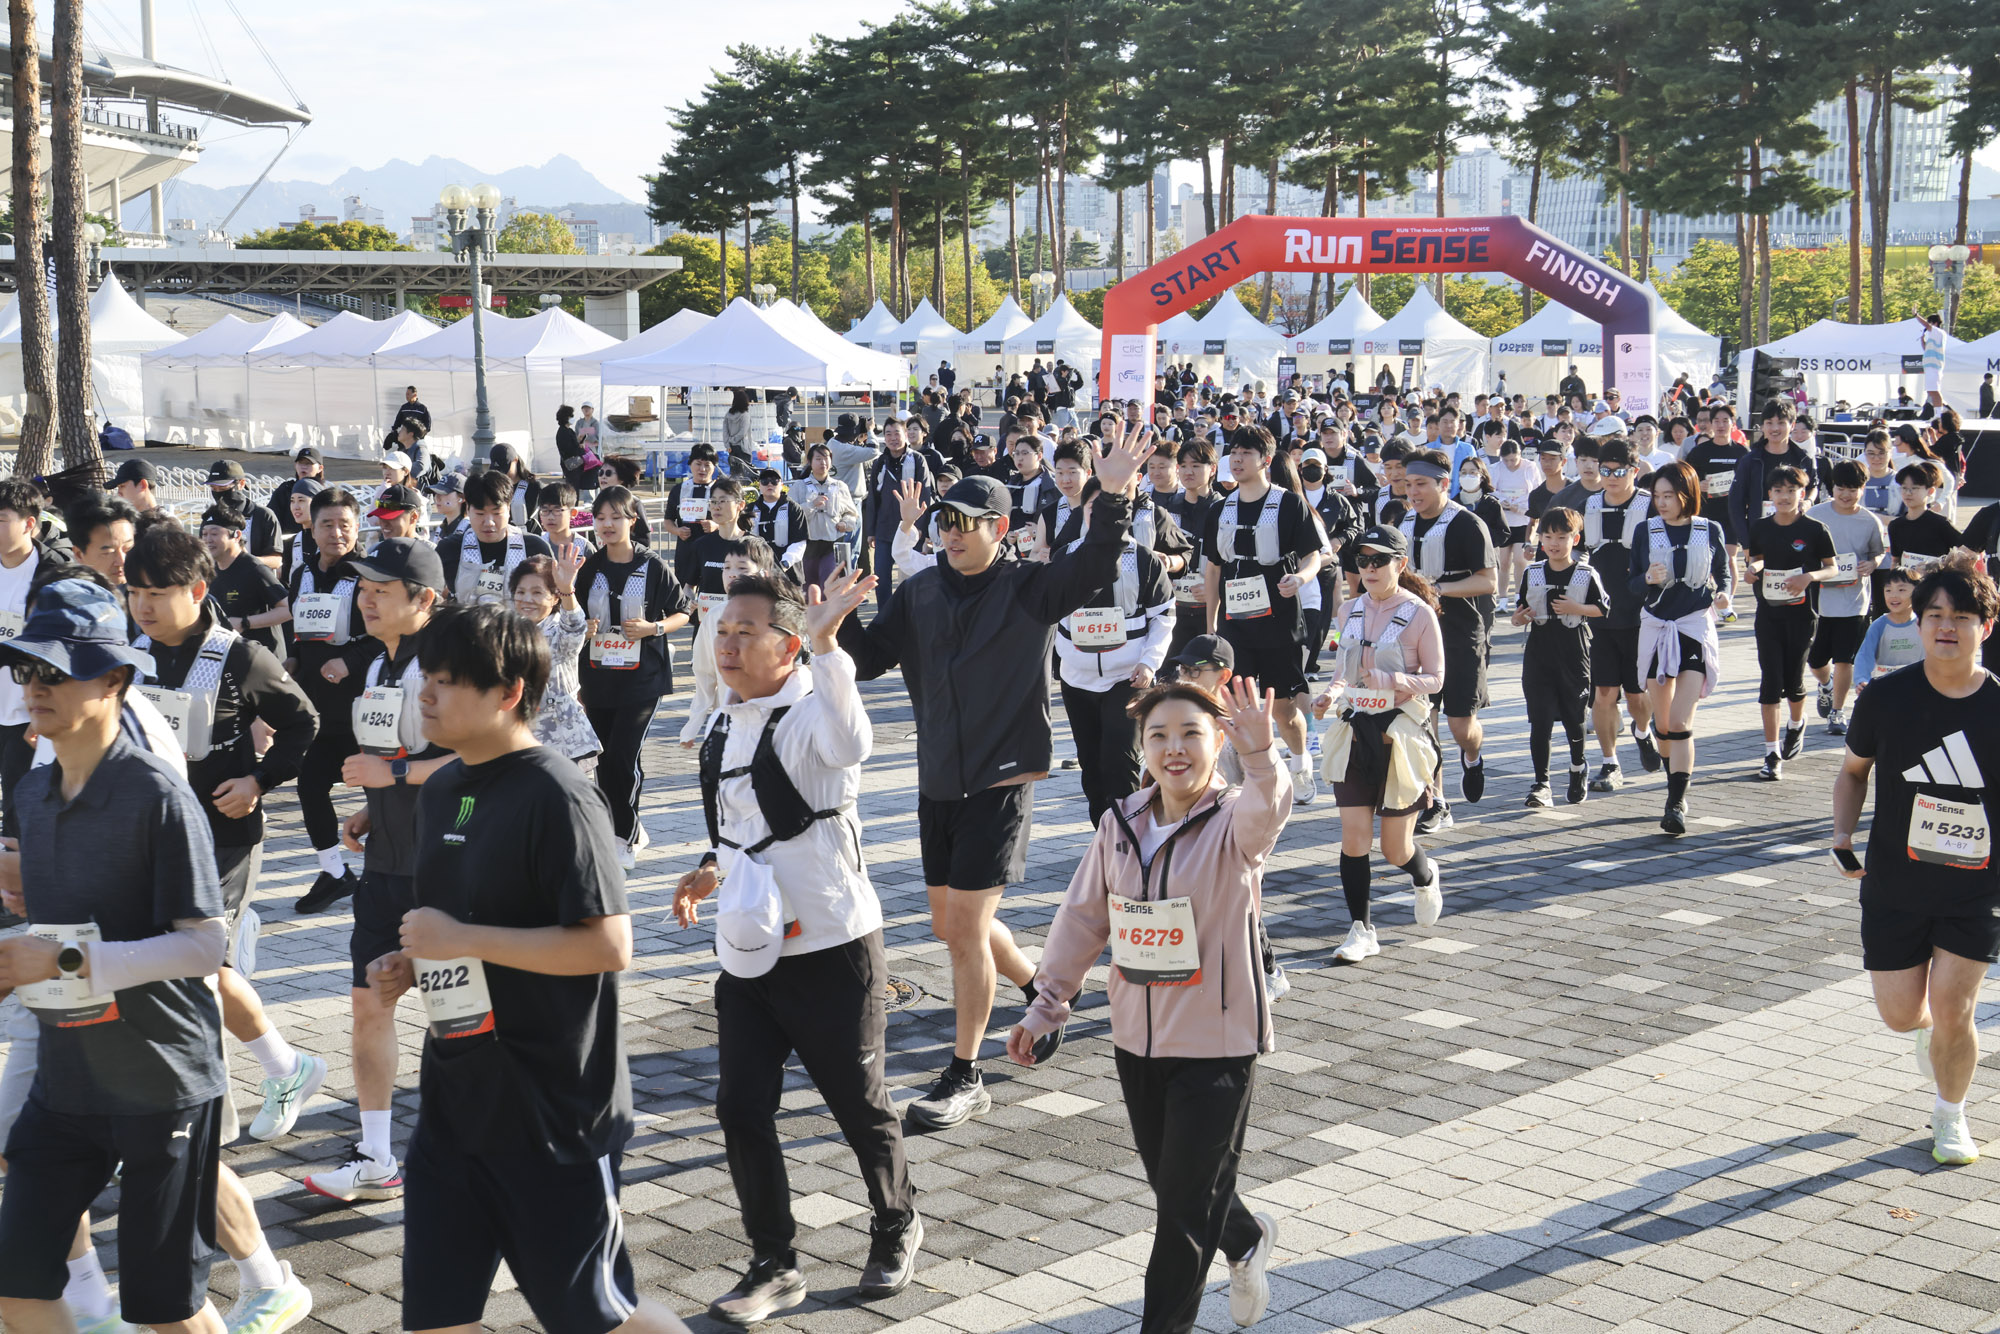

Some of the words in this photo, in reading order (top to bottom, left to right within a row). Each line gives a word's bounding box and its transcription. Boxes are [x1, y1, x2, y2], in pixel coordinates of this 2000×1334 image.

[1150, 240, 1241, 306] START
[1525, 240, 1622, 307] FINISH
[1824, 359, 1872, 370] ROOM
[1236, 590, 1261, 602] 5051
[306, 609, 332, 619] 5068
[1088, 622, 1118, 634] 6151
[604, 640, 636, 650] 6447
[369, 712, 394, 728] 5243
[1921, 820, 1934, 830] M
[1936, 822, 1986, 840] 5233
[1945, 840, 1968, 850] A-87
[1118, 928, 1128, 940] W
[1130, 928, 1184, 946] 6279
[420, 966, 470, 993] 5222
